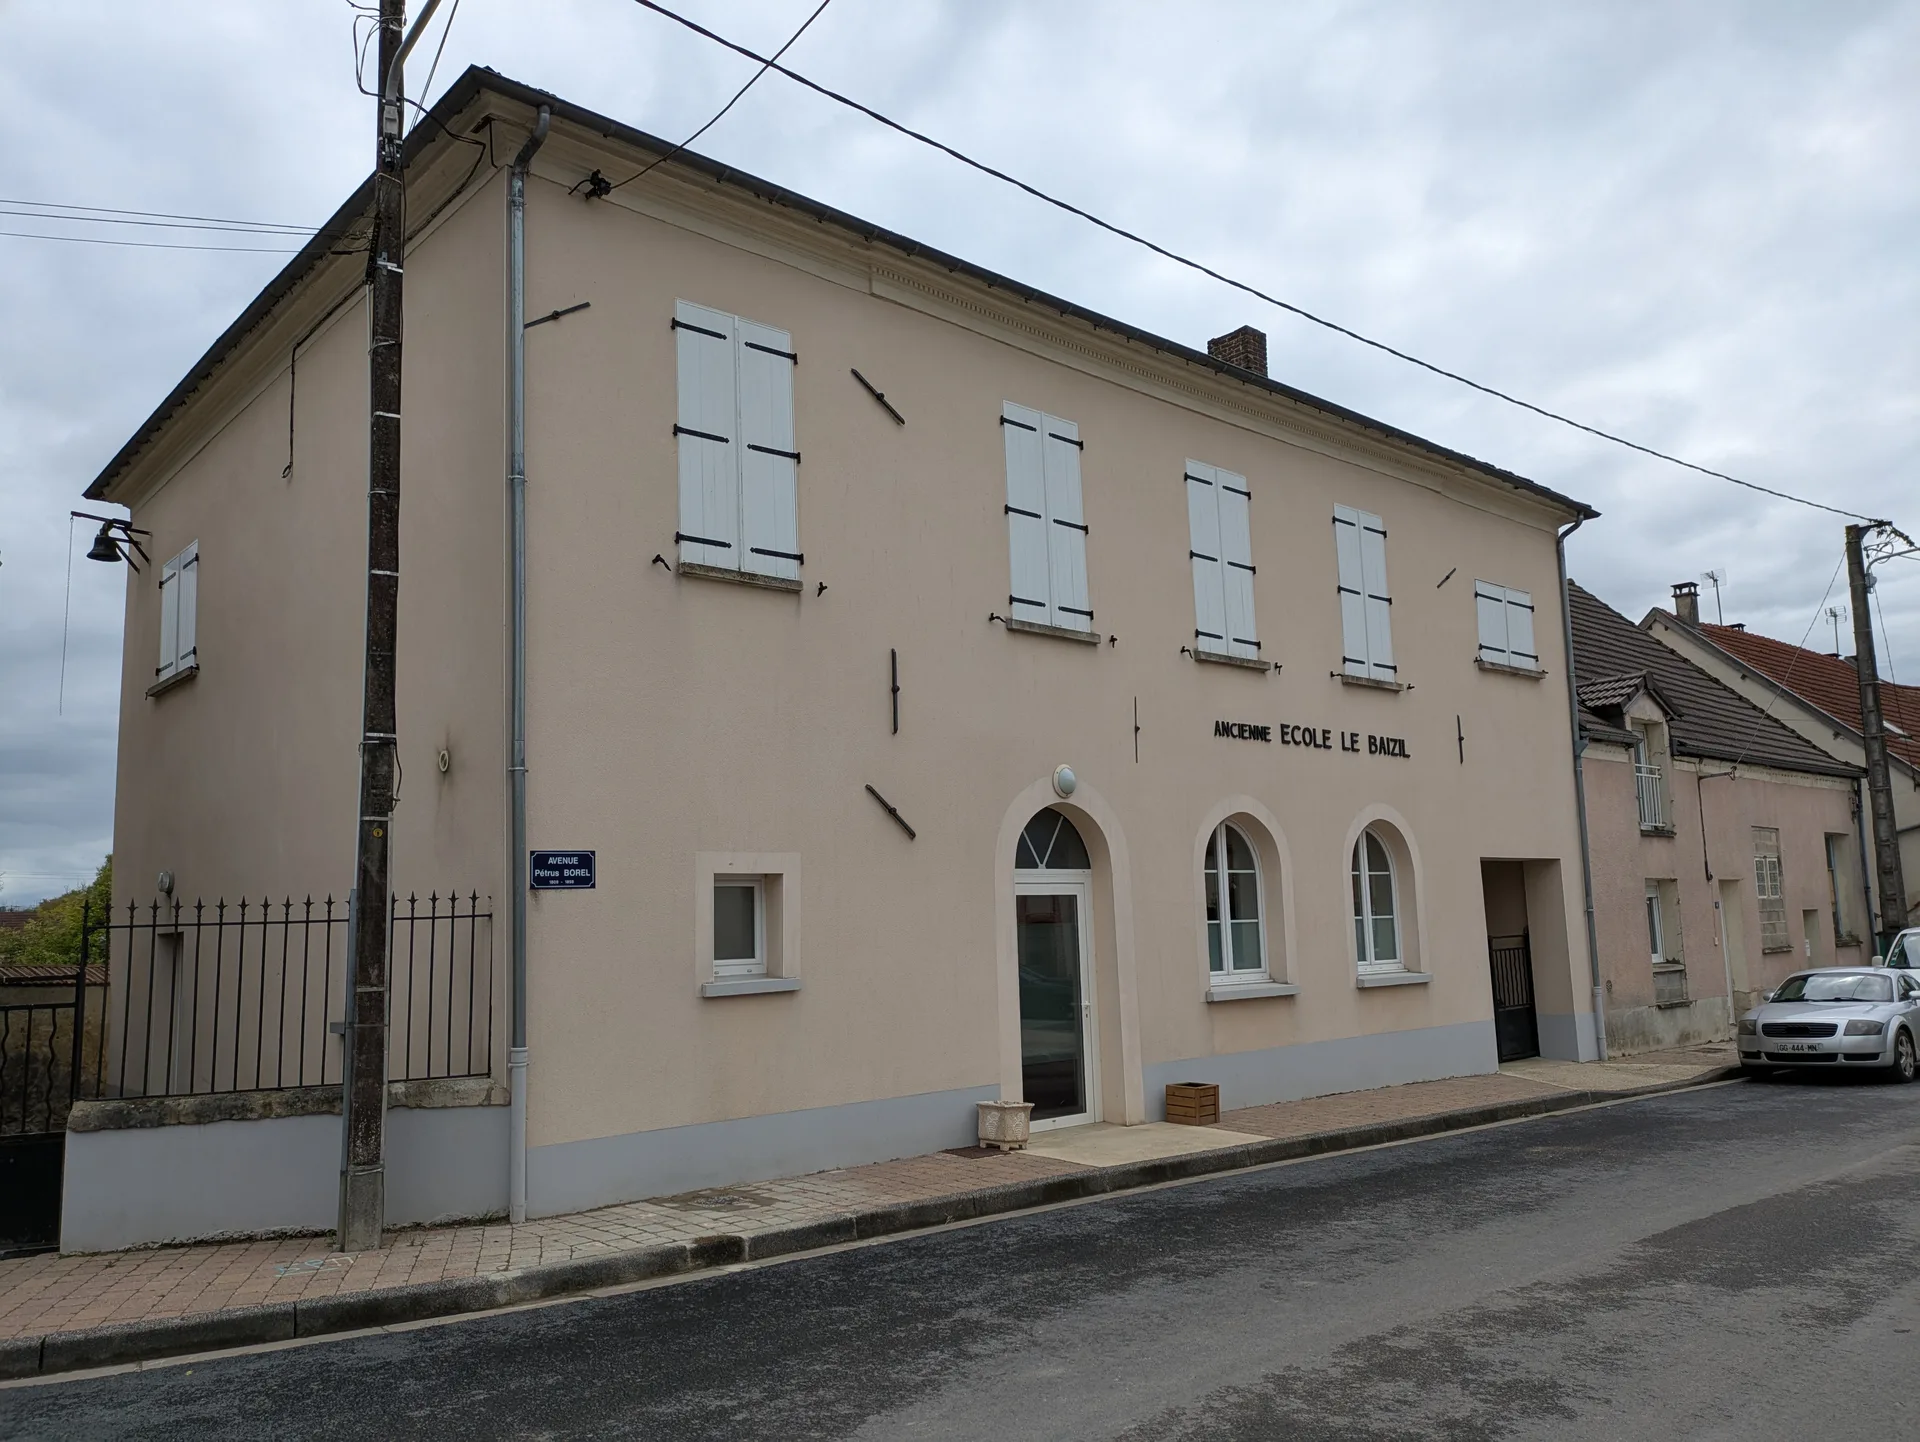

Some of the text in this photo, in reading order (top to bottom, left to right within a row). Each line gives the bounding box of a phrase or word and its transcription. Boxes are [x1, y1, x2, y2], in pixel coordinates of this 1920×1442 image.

[1213, 720, 1411, 758] ANCIENNE ECOLE LE BAIZIL
